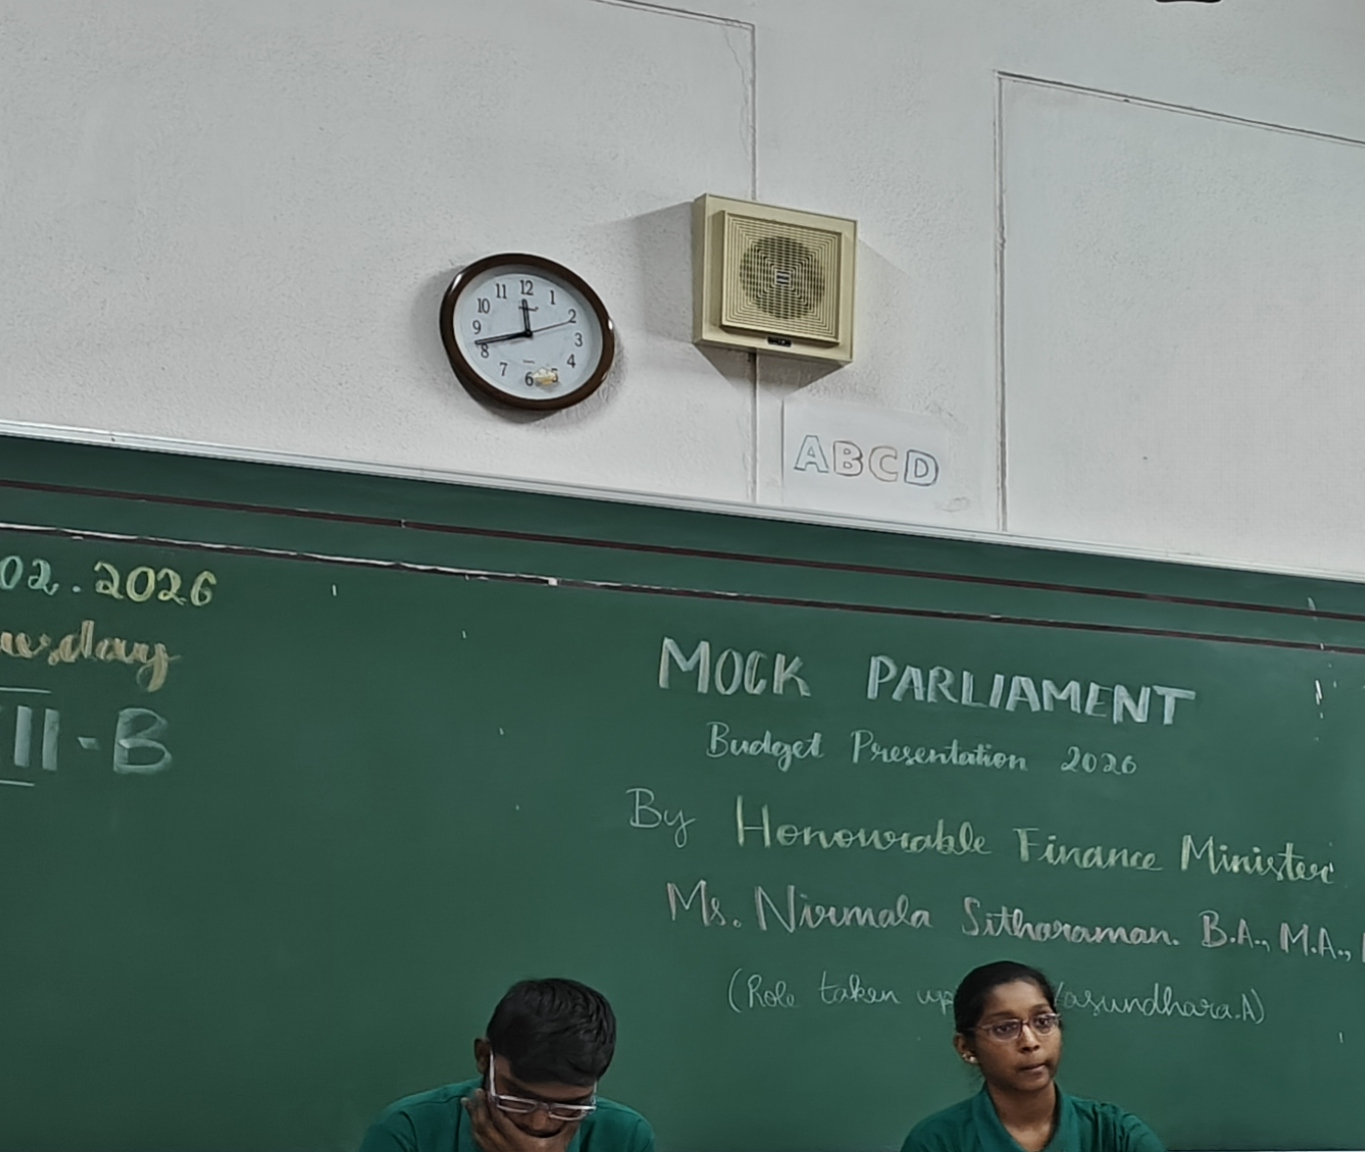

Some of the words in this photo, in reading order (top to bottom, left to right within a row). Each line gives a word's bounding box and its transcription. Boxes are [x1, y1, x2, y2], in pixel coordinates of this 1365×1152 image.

[495, 283, 507, 299] 11
[520, 280, 533, 295] 12
[550, 290, 556, 305] 1
[477, 298, 490, 314] 10
[567, 309, 577, 323] 2
[472, 320, 481, 334] 9
[574, 332, 583, 347] 3
[480, 343, 489, 358] 8
[567, 354, 576, 368] 4
[500, 362, 508, 376] 7
[525, 371, 534, 386] 6
[794, 434, 939, 487] ABCD
[659, 637, 811, 697] MOCK
[867, 655, 1196, 724] PARLIAMENT
[705, 723, 824, 771] Budget
[851, 730, 1028, 770] Presentation
[1062, 746, 1137, 775] 2026
[626, 788, 696, 848] By
[735, 796, 992, 856] Honourable
[1013, 827, 1163, 871] Finance
[1180, 834, 1334, 884] Minister
[667, 881, 742, 928] Ms.
[755, 885, 932, 933] Nirmala
[727, 968, 795, 1014] (Role
[820, 971, 900, 1004] taken
